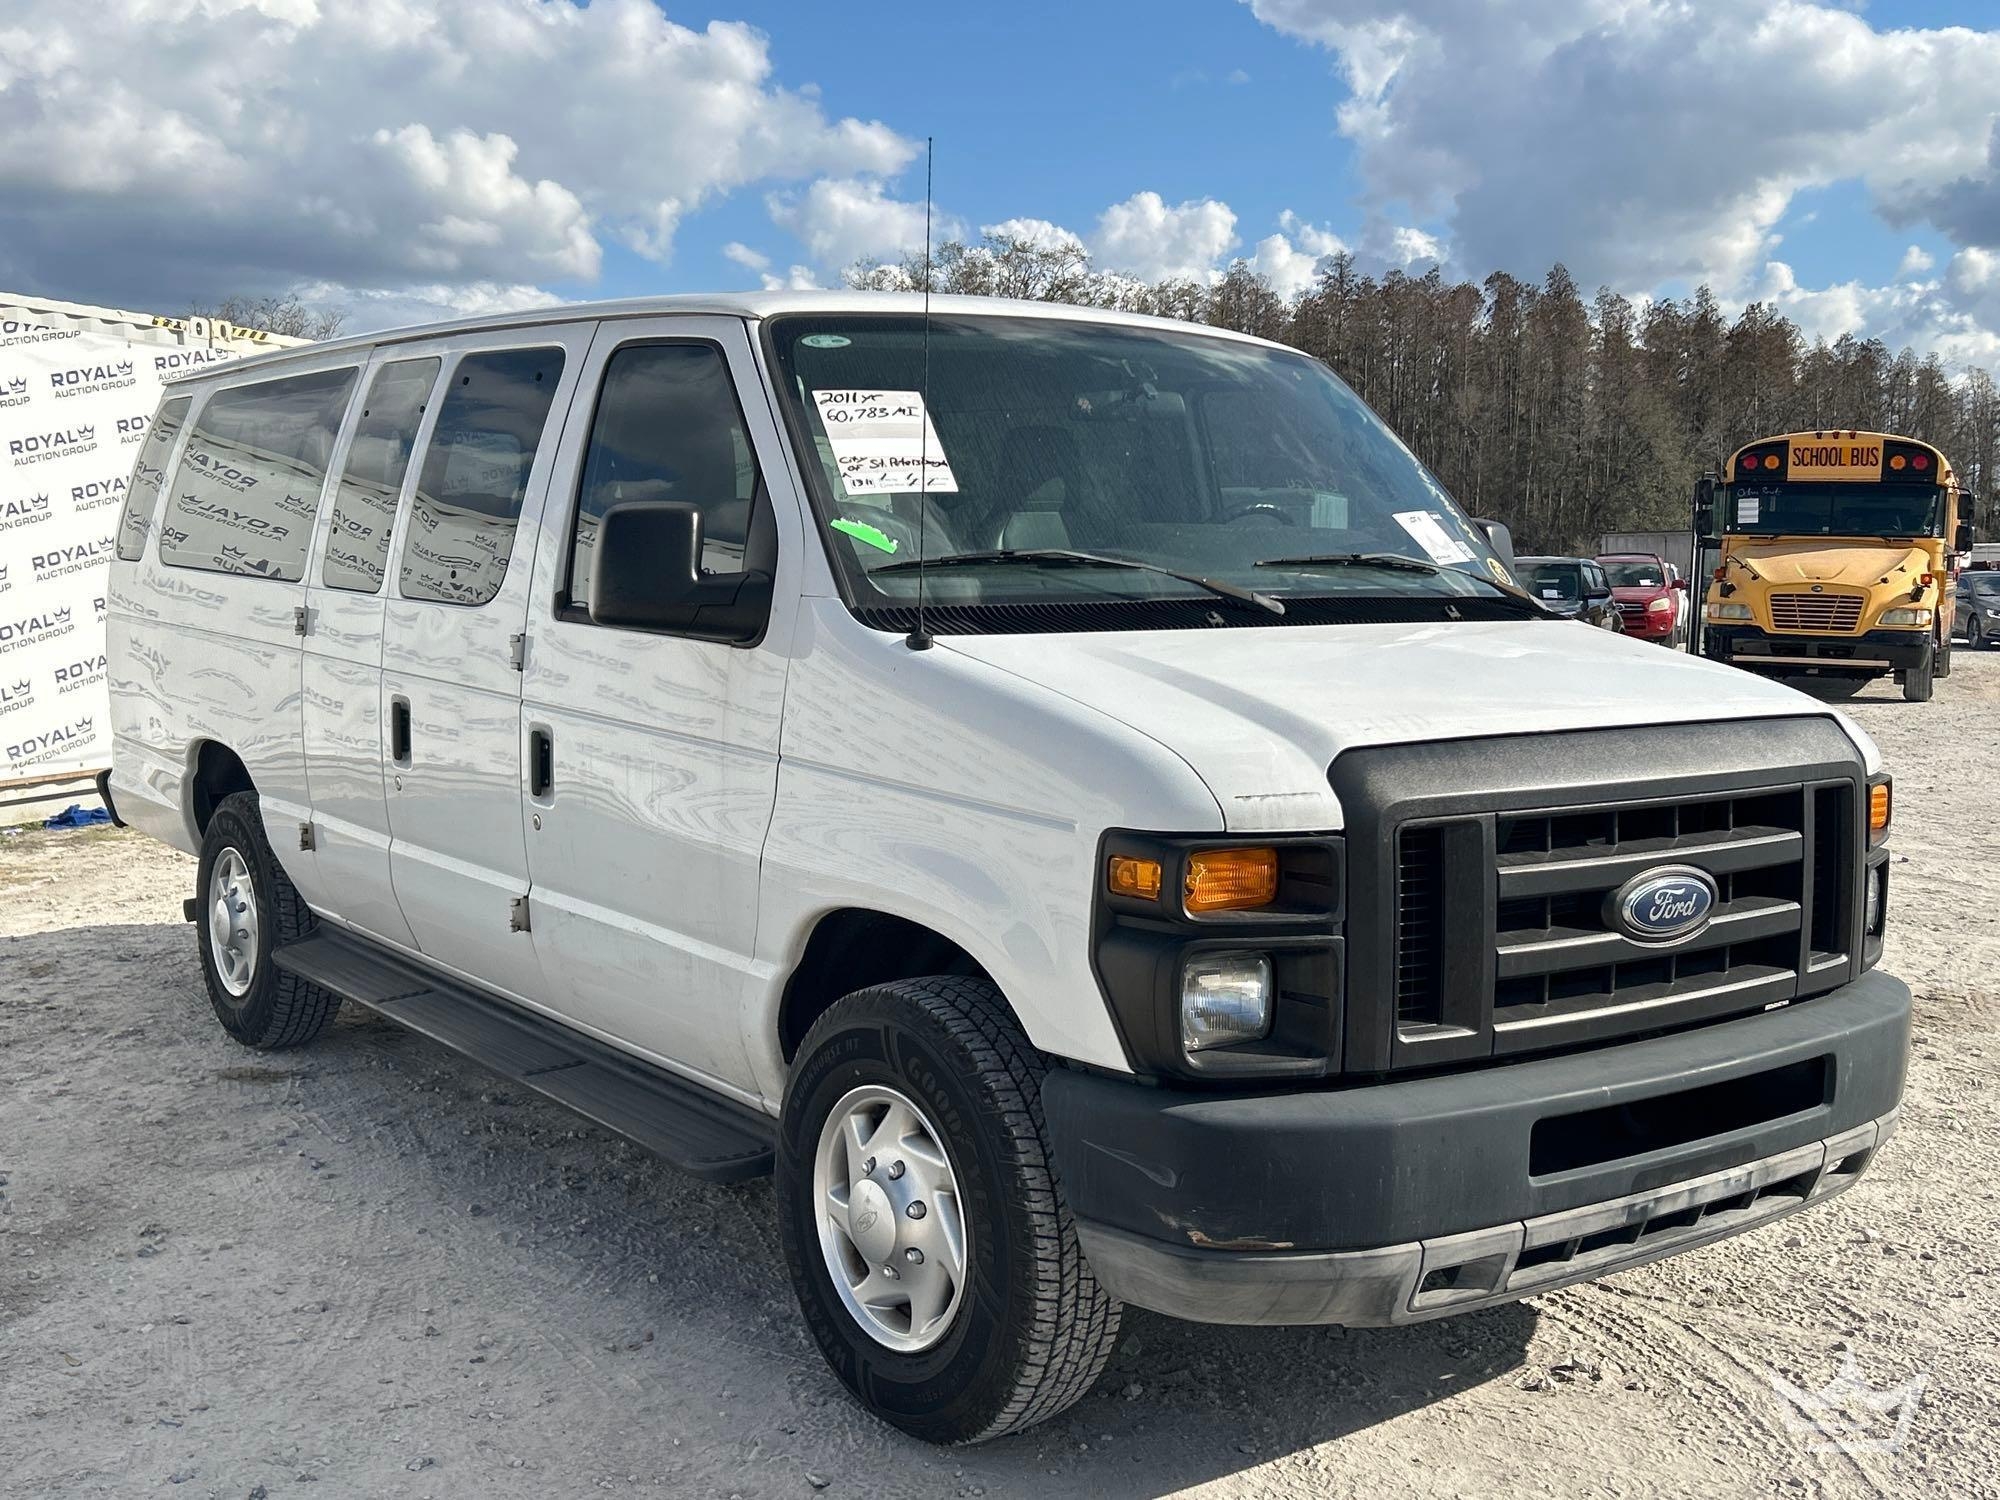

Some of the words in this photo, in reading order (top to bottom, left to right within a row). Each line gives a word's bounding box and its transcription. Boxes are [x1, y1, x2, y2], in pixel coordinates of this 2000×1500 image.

[0, 334, 40, 347] UCTION
[41, 330, 81, 342] GROUP
[154, 349, 216, 370] ROYAL
[51, 365, 117, 387] ROYAL
[55, 384, 99, 399] AUCTION
[101, 379, 136, 391] GROUP
[819, 392, 857, 405] 2011
[0, 396, 30, 408] ROUP
[826, 407, 889, 423] 60,783
[9, 430, 78, 455] ROYAL
[120, 432, 145, 445] AUCT
[14, 451, 61, 467] AUCTION
[62, 443, 98, 456] GROUP
[1792, 447, 1846, 467] SCHOOL
[1850, 447, 1879, 467] BUS
[71, 475, 130, 501] ROYA
[75, 495, 120, 513] AUCTION
[14, 511, 53, 528] GROUP
[32, 542, 99, 571] ROYAL
[36, 563, 82, 583] AUCTION
[83, 555, 112, 569] GROU
[0, 614, 54, 641] OYAL
[0, 635, 36, 654] CTION
[37, 624, 75, 642] GROUP
[54, 655, 107, 683] ROYA
[59, 673, 104, 695] AUCTION
[6, 726, 76, 761] ROYAL
[10, 748, 60, 771] AUCTION
[61, 733, 96, 753] GROUP
[1649, 887, 1697, 921] Ford
